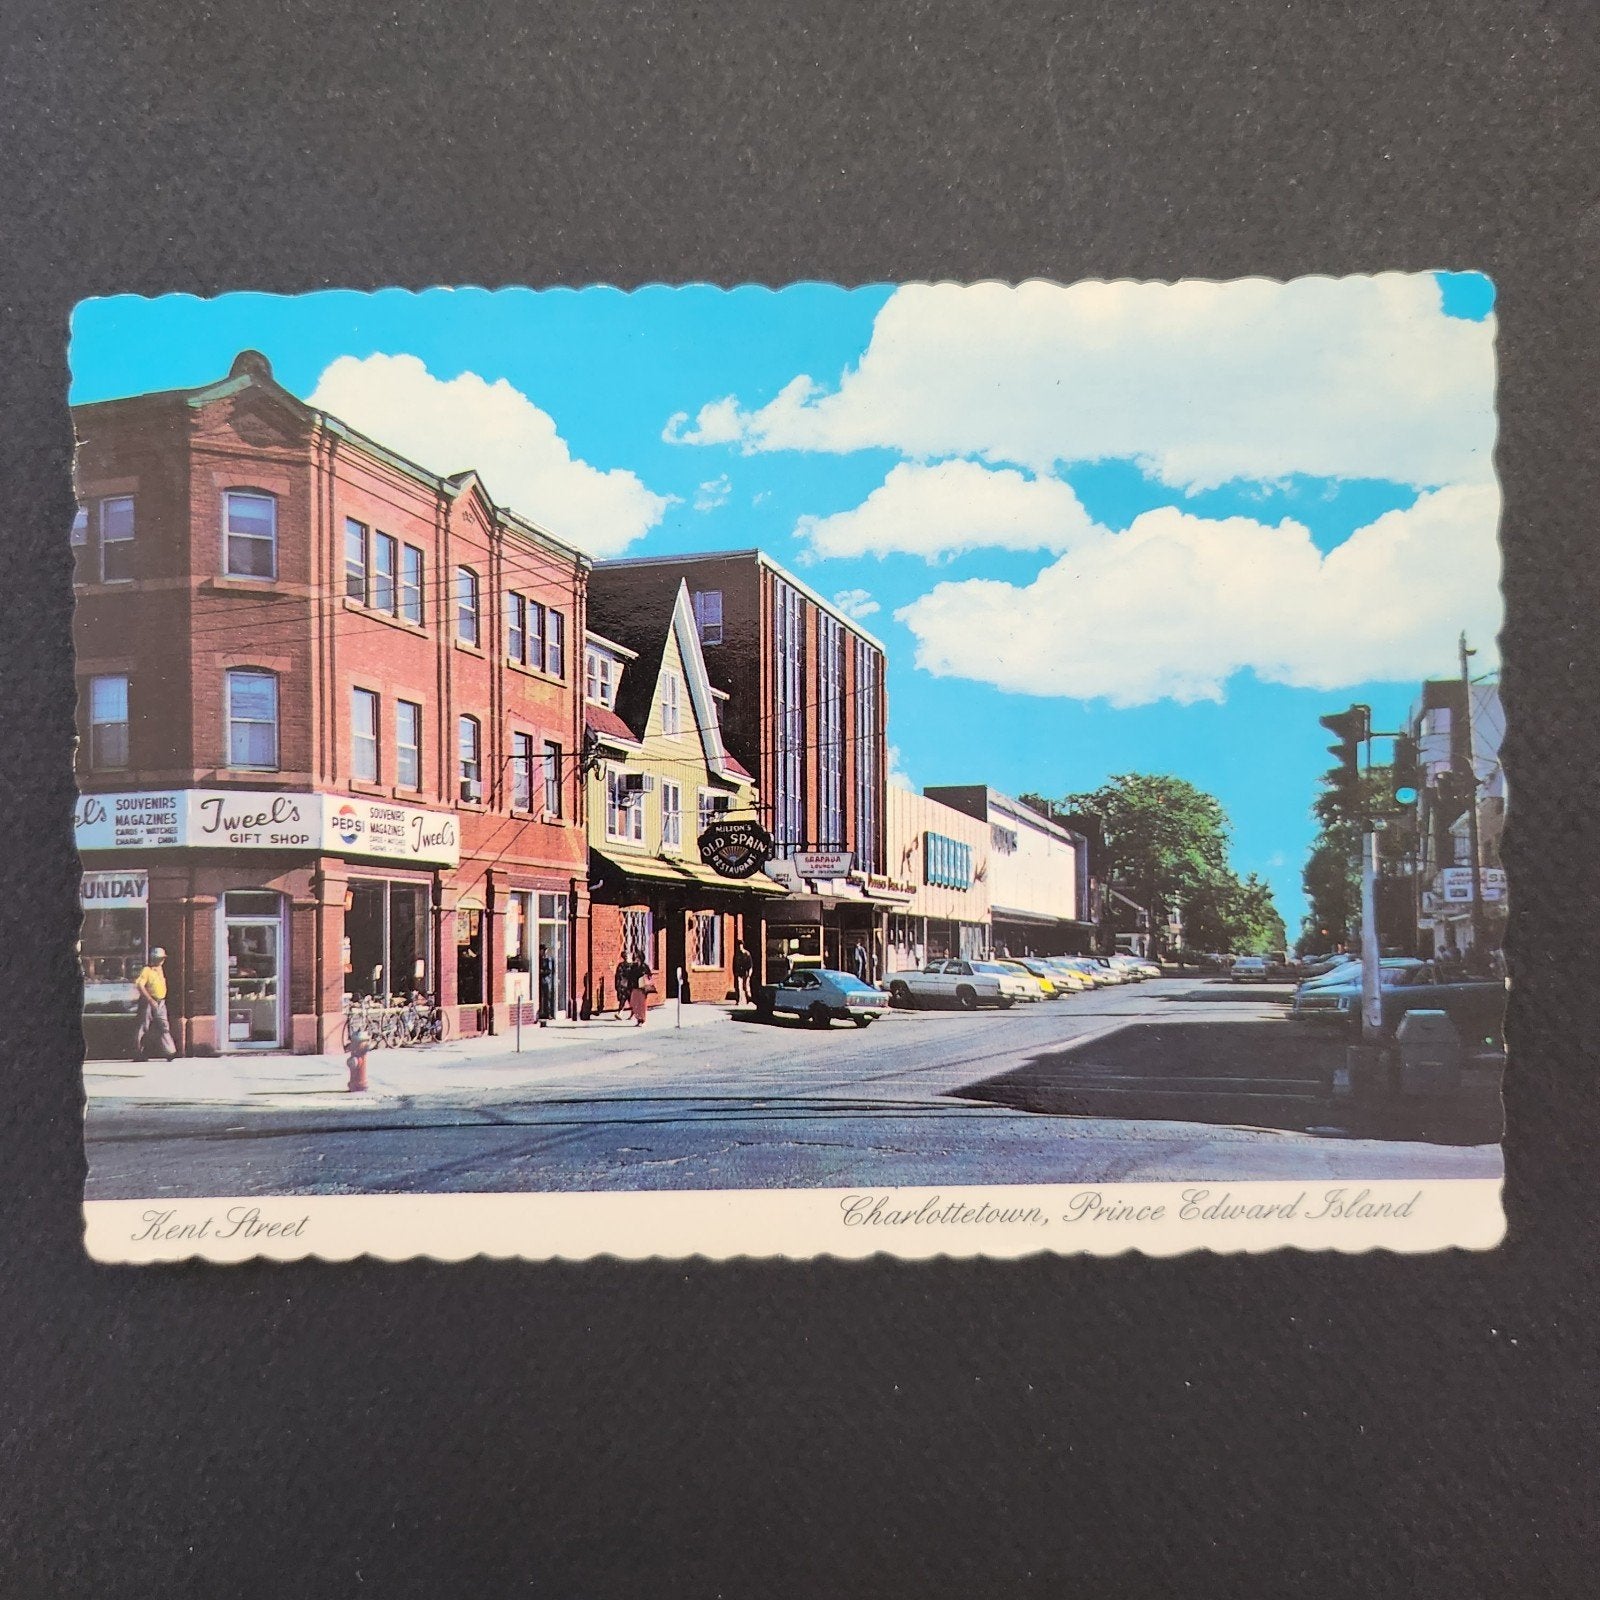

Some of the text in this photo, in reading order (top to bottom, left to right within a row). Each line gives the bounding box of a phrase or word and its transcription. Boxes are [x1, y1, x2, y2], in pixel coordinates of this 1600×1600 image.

[115, 797, 177, 810] SOUVENIRS
[115, 813, 178, 826] MAGAZINES
[200, 797, 300, 833] Tweel's
[332, 817, 365, 833] PEPSI
[230, 833, 309, 844] GIFT SHOP
[369, 822, 405, 837] MAGAZINES
[411, 816, 455, 853] Tweel's
[702, 837, 725, 857] OLD
[730, 833, 768, 853] SPAIN
[712, 853, 757, 874] RESTAURANT
[80, 879, 146, 899] UNDAY
[839, 1188, 1423, 1228] Charlottetown, Prince Edward Island
[131, 1206, 311, 1241] Kent Street
